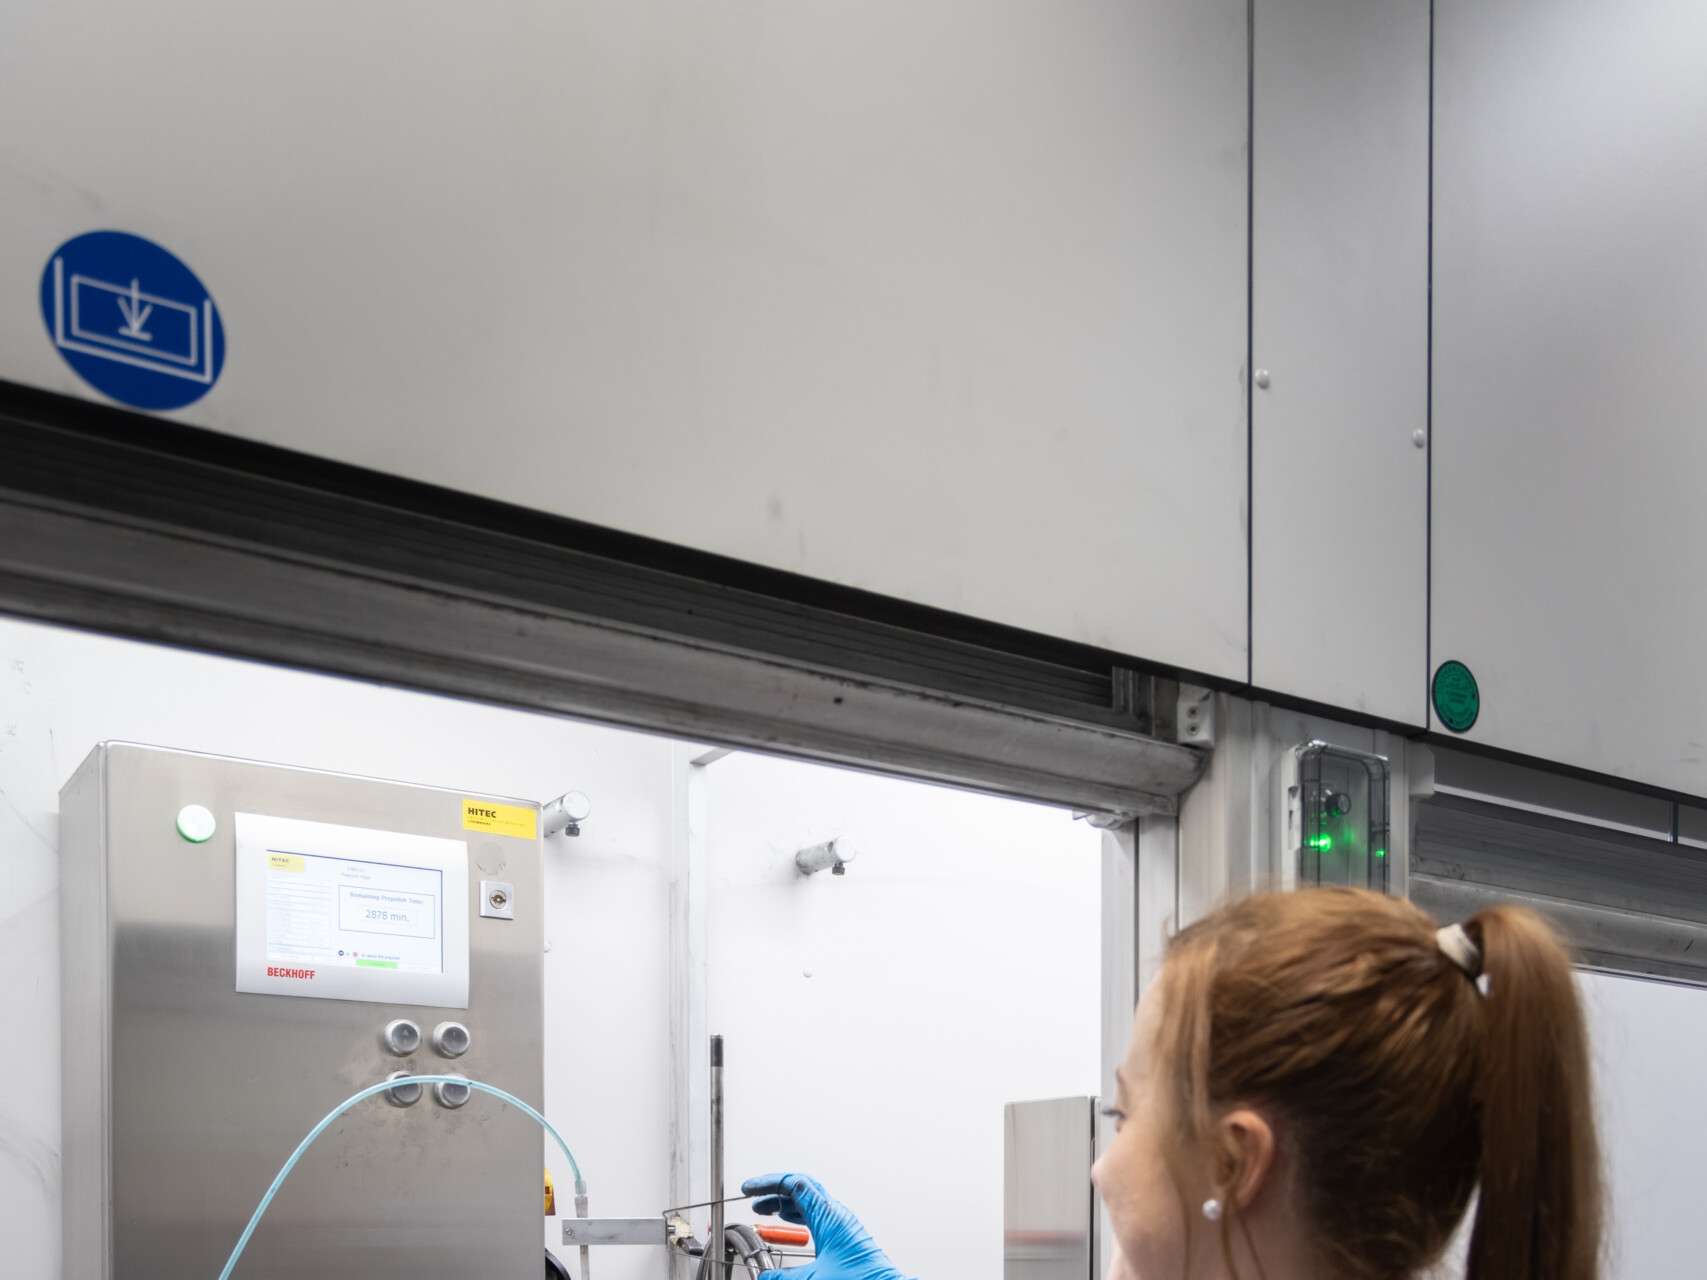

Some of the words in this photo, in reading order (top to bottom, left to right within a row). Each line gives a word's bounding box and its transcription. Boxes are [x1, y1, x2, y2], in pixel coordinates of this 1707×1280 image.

[468, 807, 497, 818] HITEC
[350, 892, 379, 901] Remaining
[365, 909, 388, 920] 2878
[390, 912, 410, 922] min.
[267, 967, 316, 979] BECKHOFF
